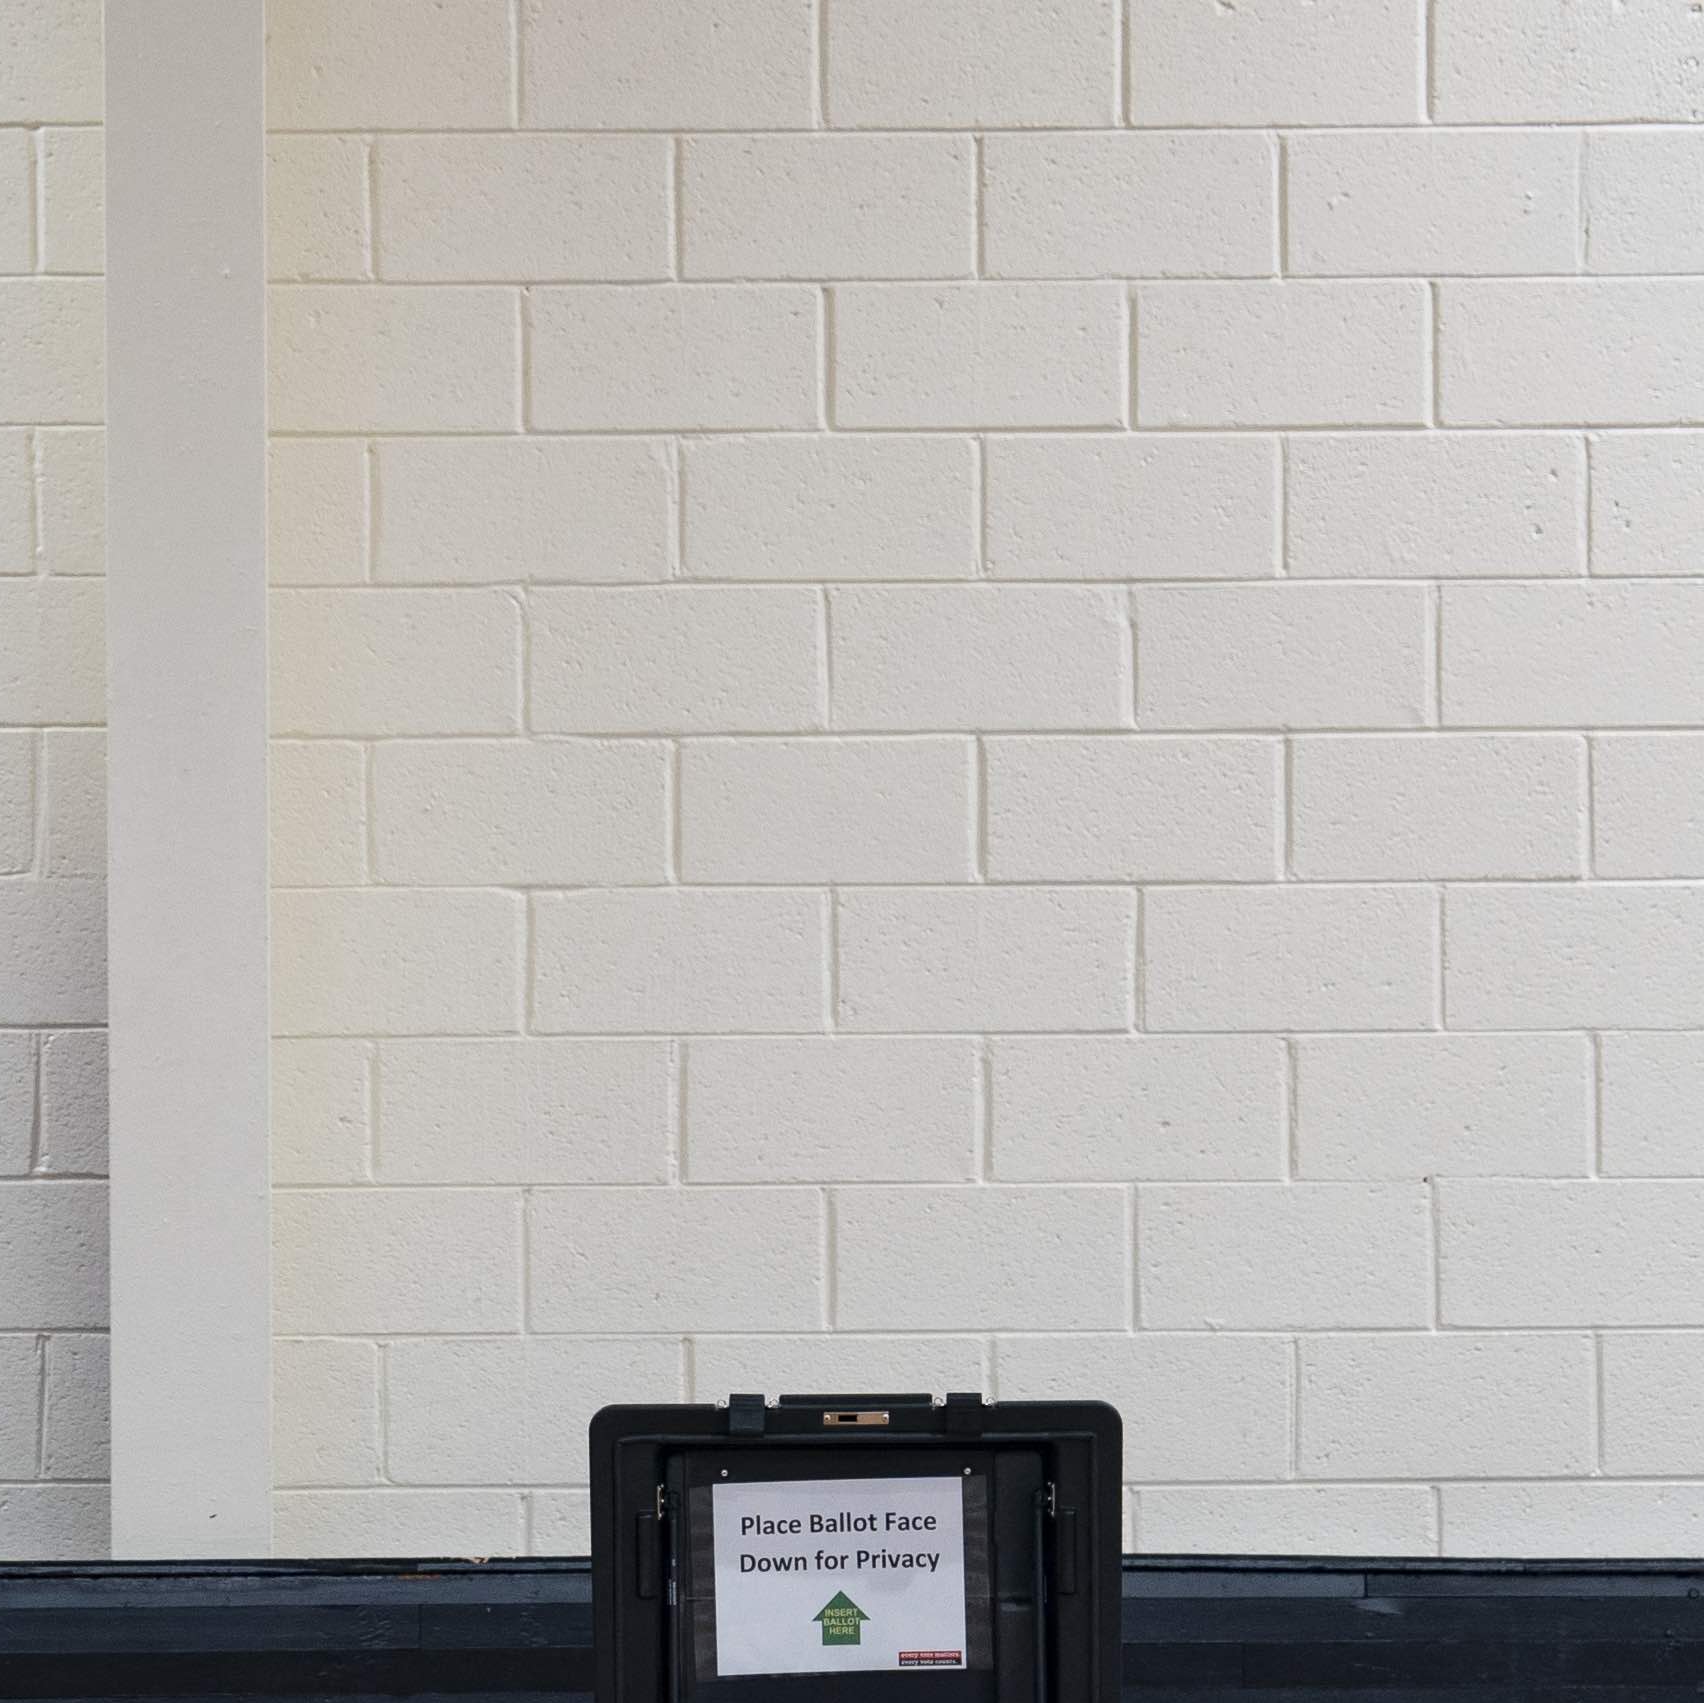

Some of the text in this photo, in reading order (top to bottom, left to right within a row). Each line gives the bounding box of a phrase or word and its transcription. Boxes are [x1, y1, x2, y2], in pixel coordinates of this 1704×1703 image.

[741, 1512, 937, 1535] Place Ballot Face
[740, 1549, 940, 1573] Down for Privacy
[824, 1608, 859, 1617] INSERT
[823, 1617, 860, 1626] BALLOT
[829, 1626, 856, 1635] HERE
